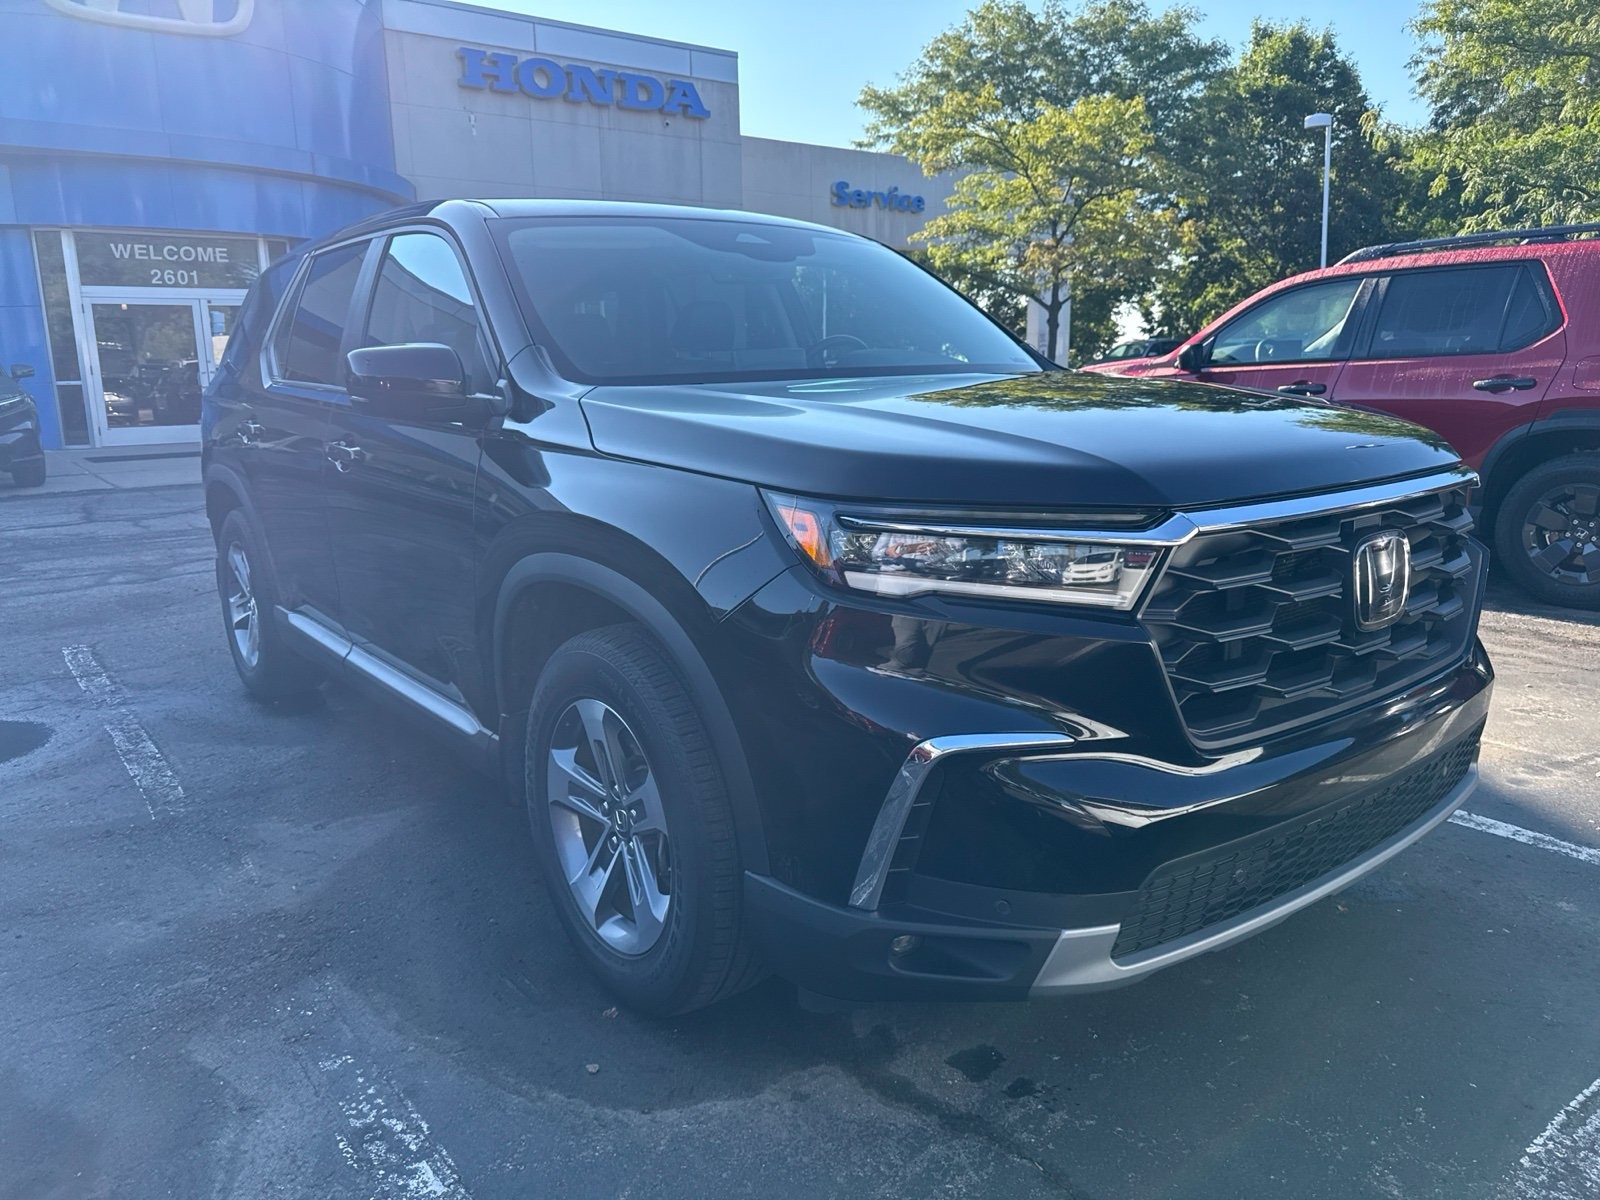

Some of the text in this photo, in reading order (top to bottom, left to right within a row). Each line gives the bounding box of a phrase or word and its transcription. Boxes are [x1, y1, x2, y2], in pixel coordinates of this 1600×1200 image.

[458, 47, 710, 119] HONDA
[831, 181, 925, 214] Service
[110, 243, 229, 263] WELCOME
[150, 269, 199, 285] 2601
